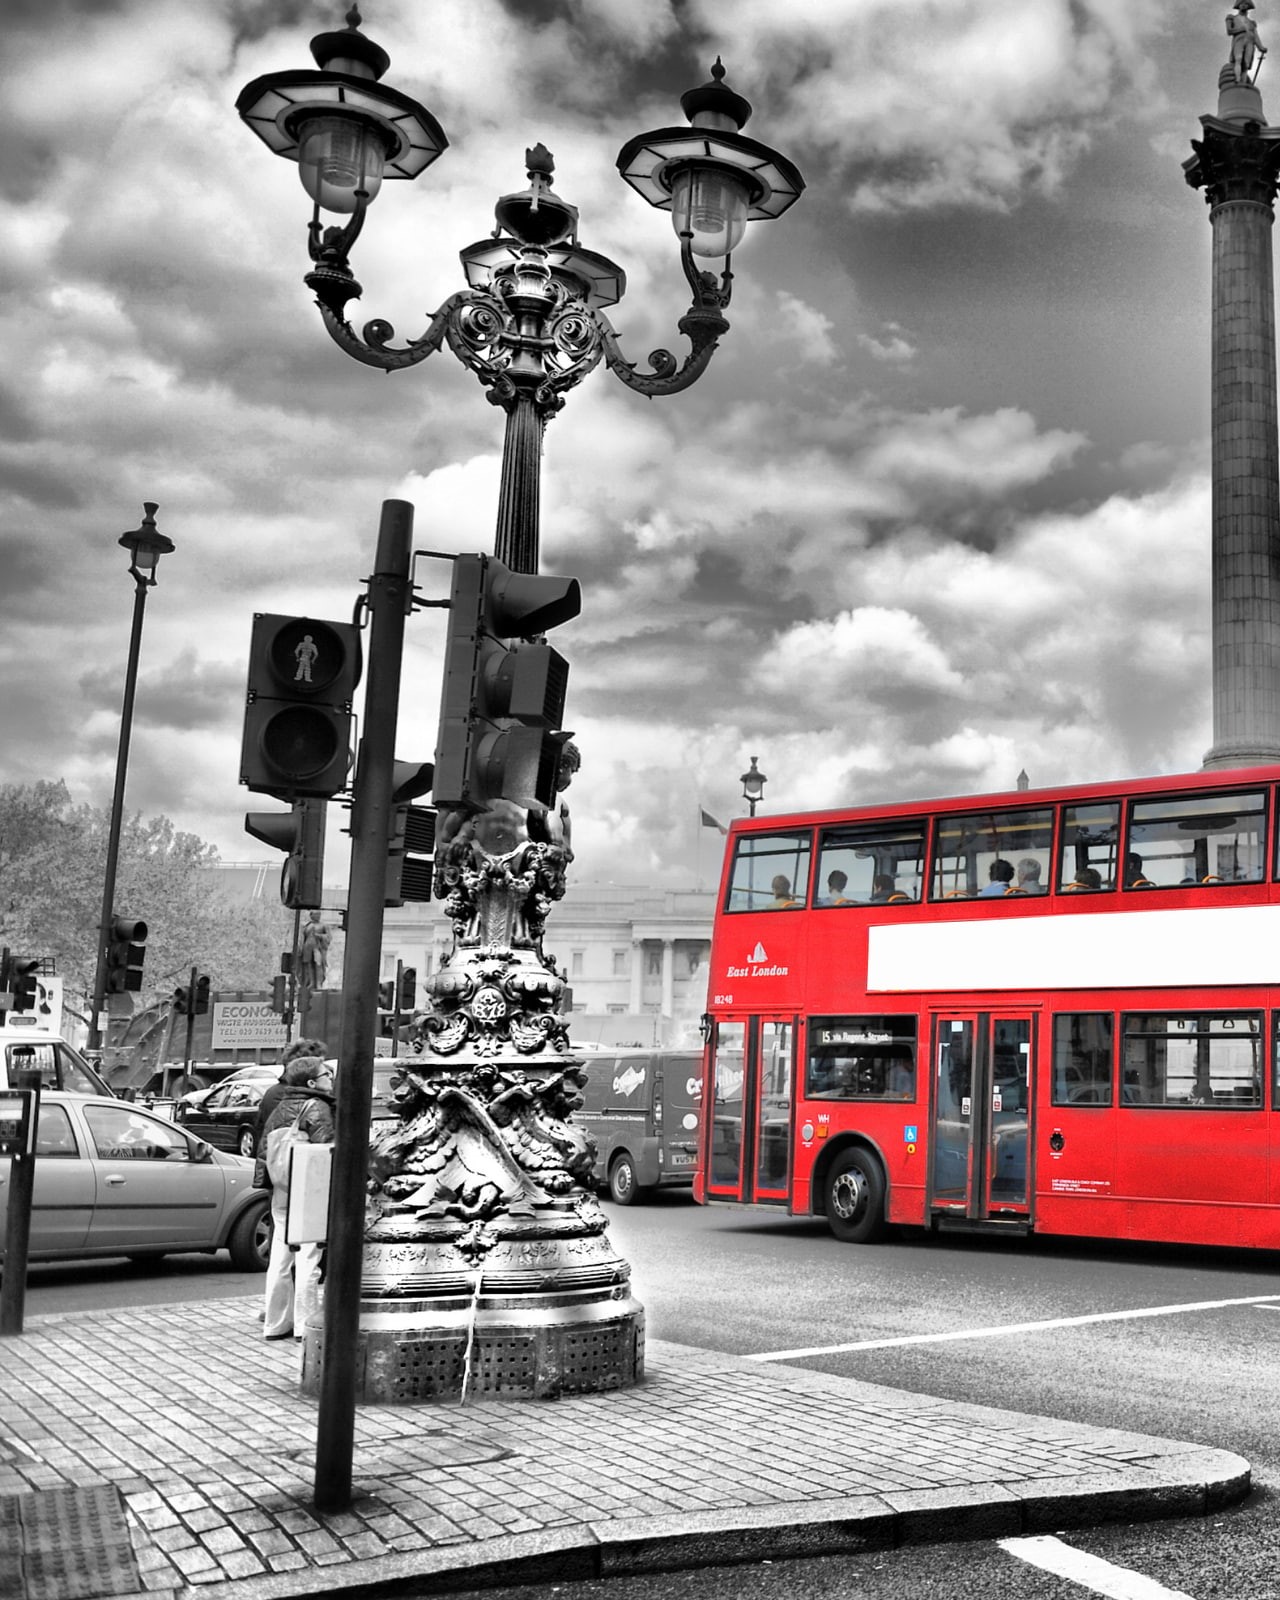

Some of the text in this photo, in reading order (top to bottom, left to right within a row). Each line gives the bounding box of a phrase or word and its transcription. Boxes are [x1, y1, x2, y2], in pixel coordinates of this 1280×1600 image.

[727, 964, 789, 977] East London
[220, 1028, 237, 1036] TEL:
[822, 1031, 831, 1043] 15
